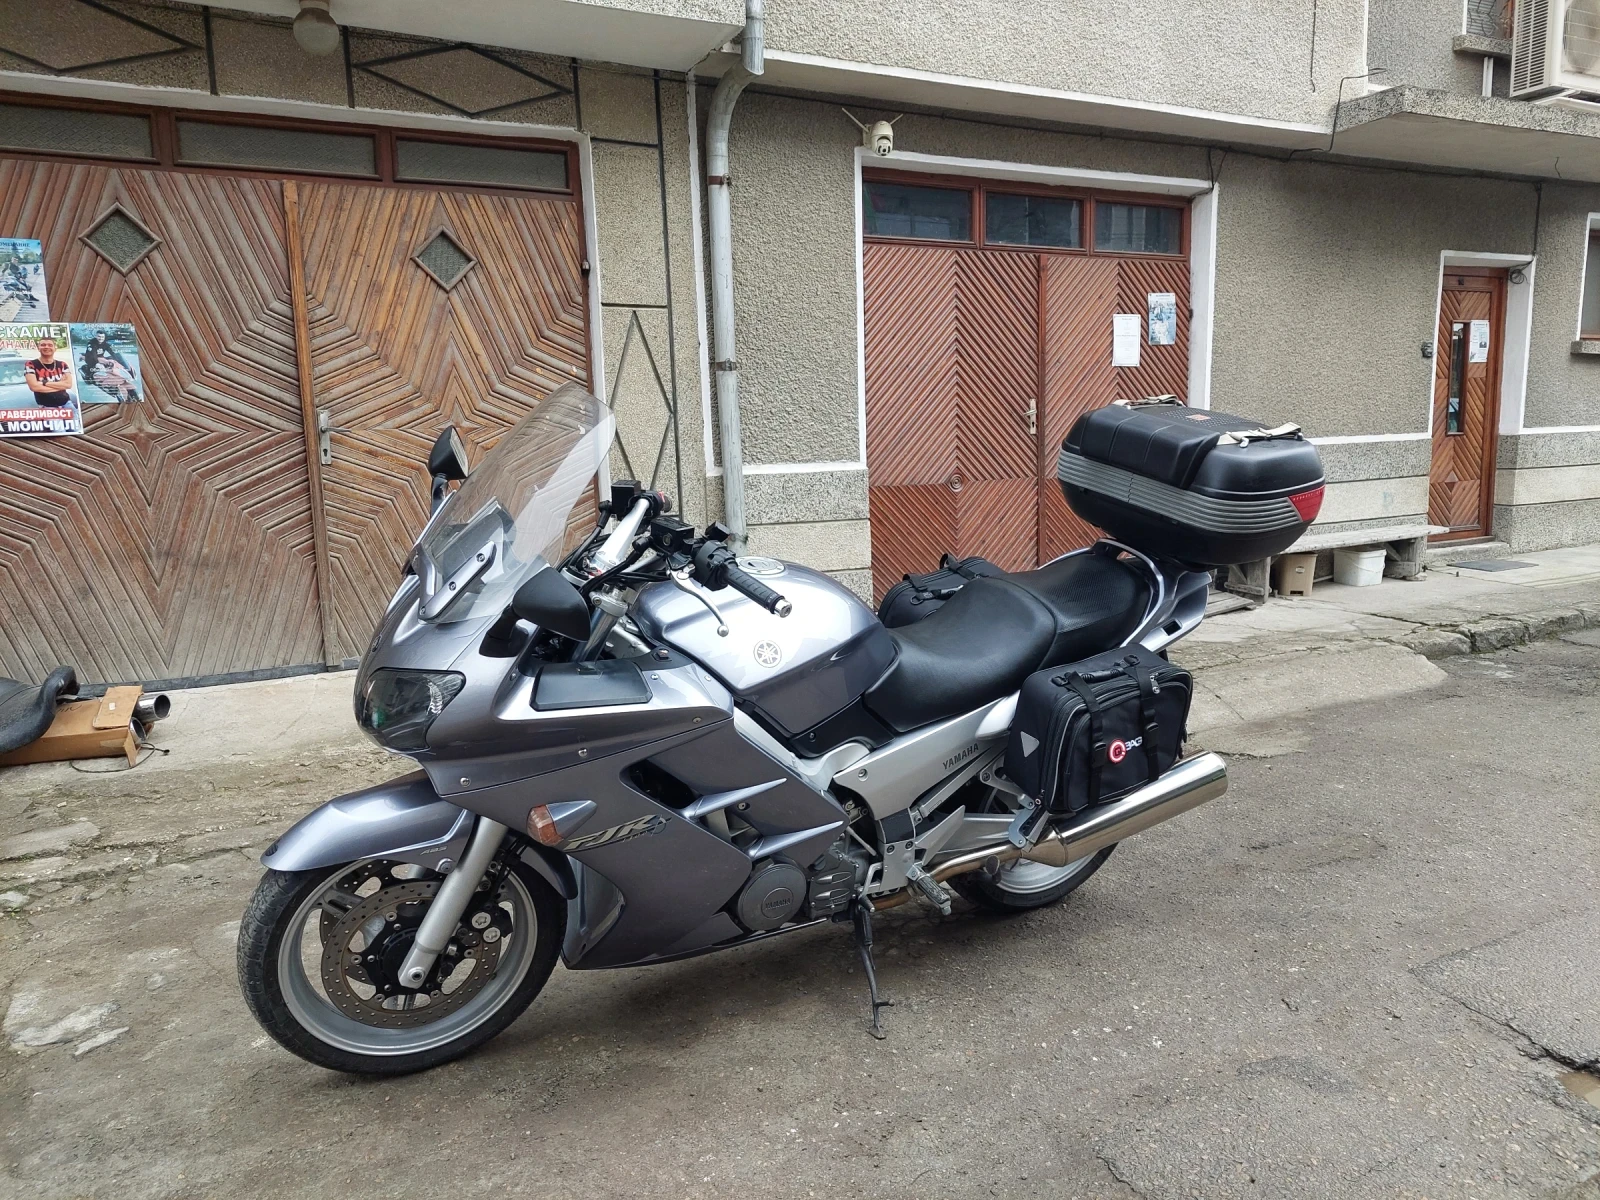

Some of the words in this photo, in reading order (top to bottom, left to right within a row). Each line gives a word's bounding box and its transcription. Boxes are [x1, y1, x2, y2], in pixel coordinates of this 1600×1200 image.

[0, 408, 72, 420] РАВЕДЛИВОСТ
[7, 419, 79, 432] МОМЧИЛ!
[942, 742, 979, 770] YAMAHA
[562, 814, 657, 850] FJR
[765, 898, 791, 909] YAMAHA
